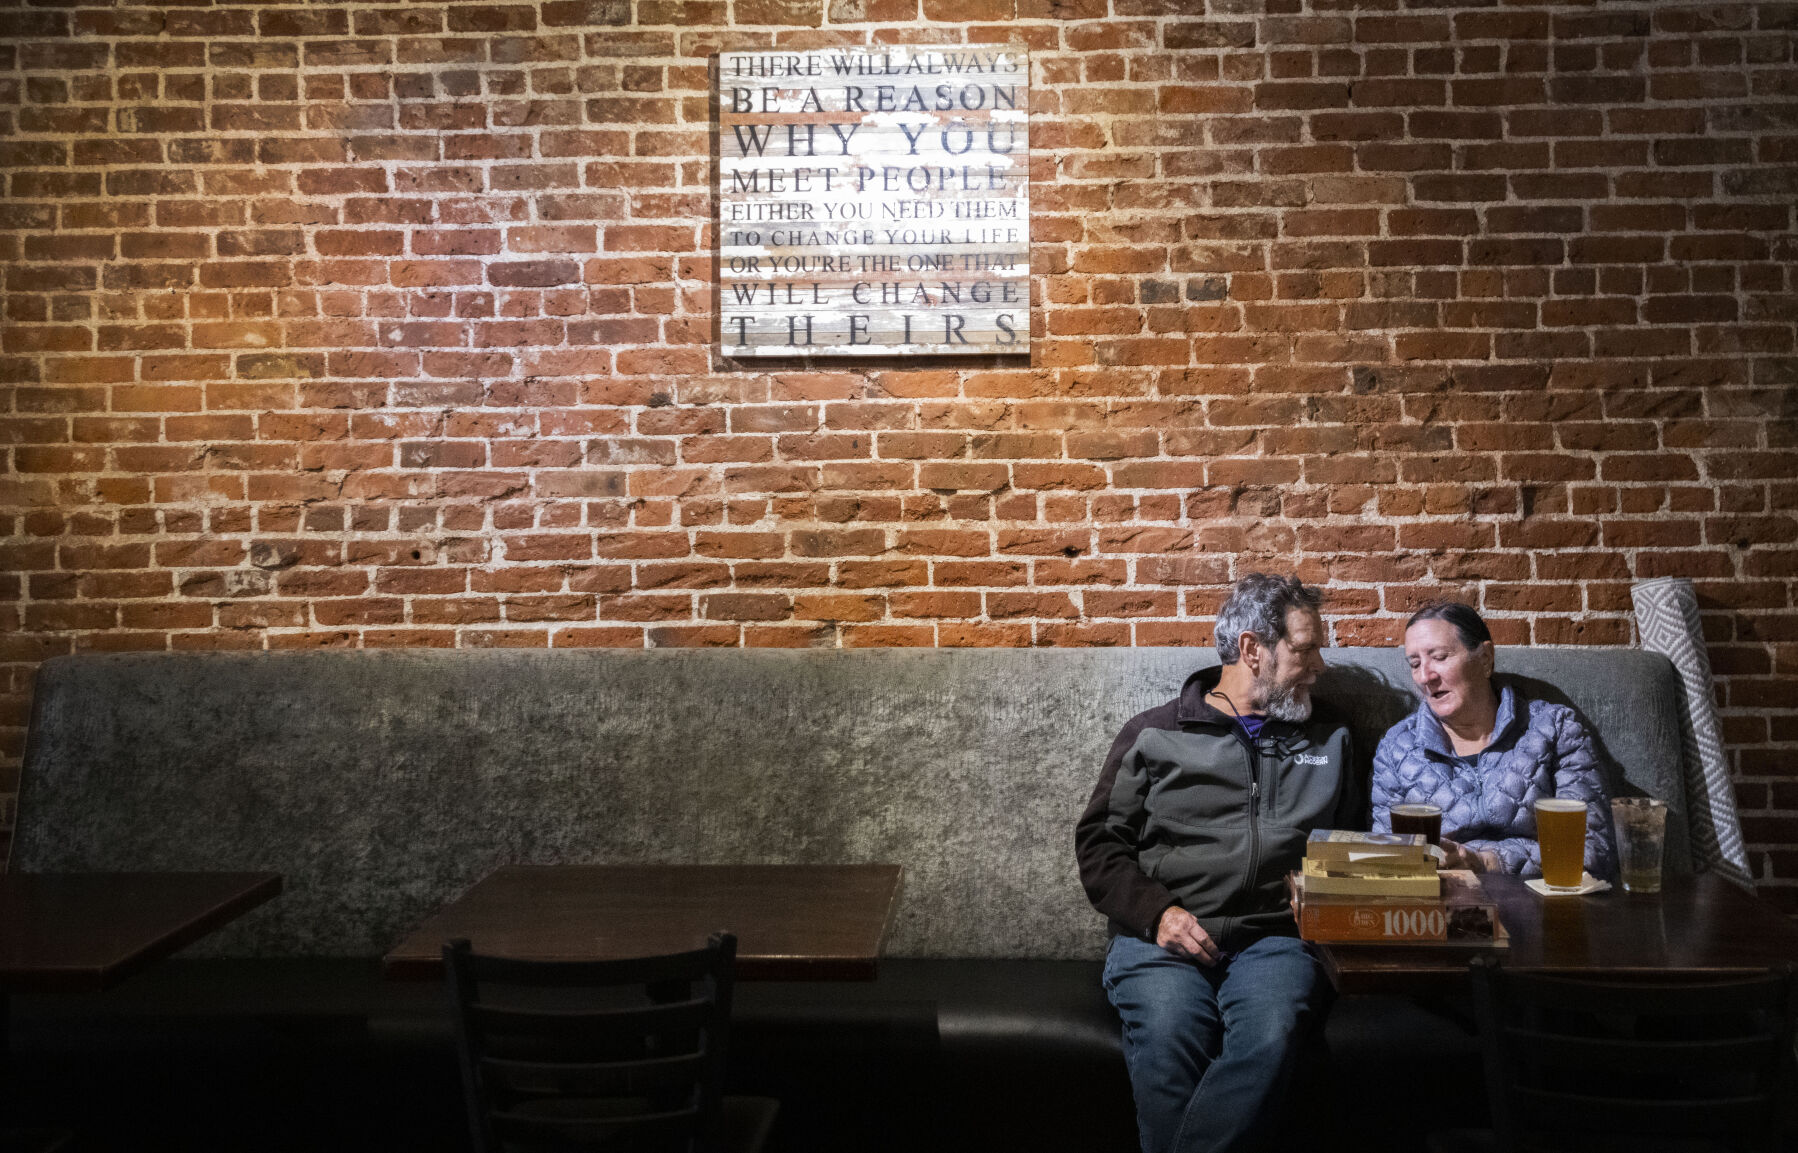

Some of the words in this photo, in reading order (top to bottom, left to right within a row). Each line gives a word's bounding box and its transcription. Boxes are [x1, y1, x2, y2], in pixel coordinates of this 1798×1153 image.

[730, 55, 822, 76] THERE
[831, 55, 902, 75] WILL
[906, 53, 1019, 74] ALWAYS
[732, 87, 780, 114] BE
[801, 87, 824, 113] A
[844, 84, 1016, 112] REASON
[732, 124, 861, 157] WHY
[897, 121, 1015, 155] YOU
[732, 167, 838, 193] MEET
[859, 166, 1006, 191] PEOPLE
[732, 203, 815, 220] EITHER
[824, 203, 872, 219] YOU
[882, 202, 944, 221] NEED
[952, 201, 1017, 218] THEM
[731, 231, 761, 245] TO
[772, 230, 874, 245] CHANGE
[885, 230, 951, 244] YOUR
[965, 229, 1019, 243] LIFE
[730, 256, 759, 273] OR
[768, 255, 850, 272] YOU'RE
[857, 255, 901, 272] THE
[908, 255, 953, 271] ONE
[960, 254, 1016, 271] THAT
[732, 283, 829, 305] WILL
[852, 281, 1019, 304] CHANGE
[1383, 909, 1445, 936] 1000
